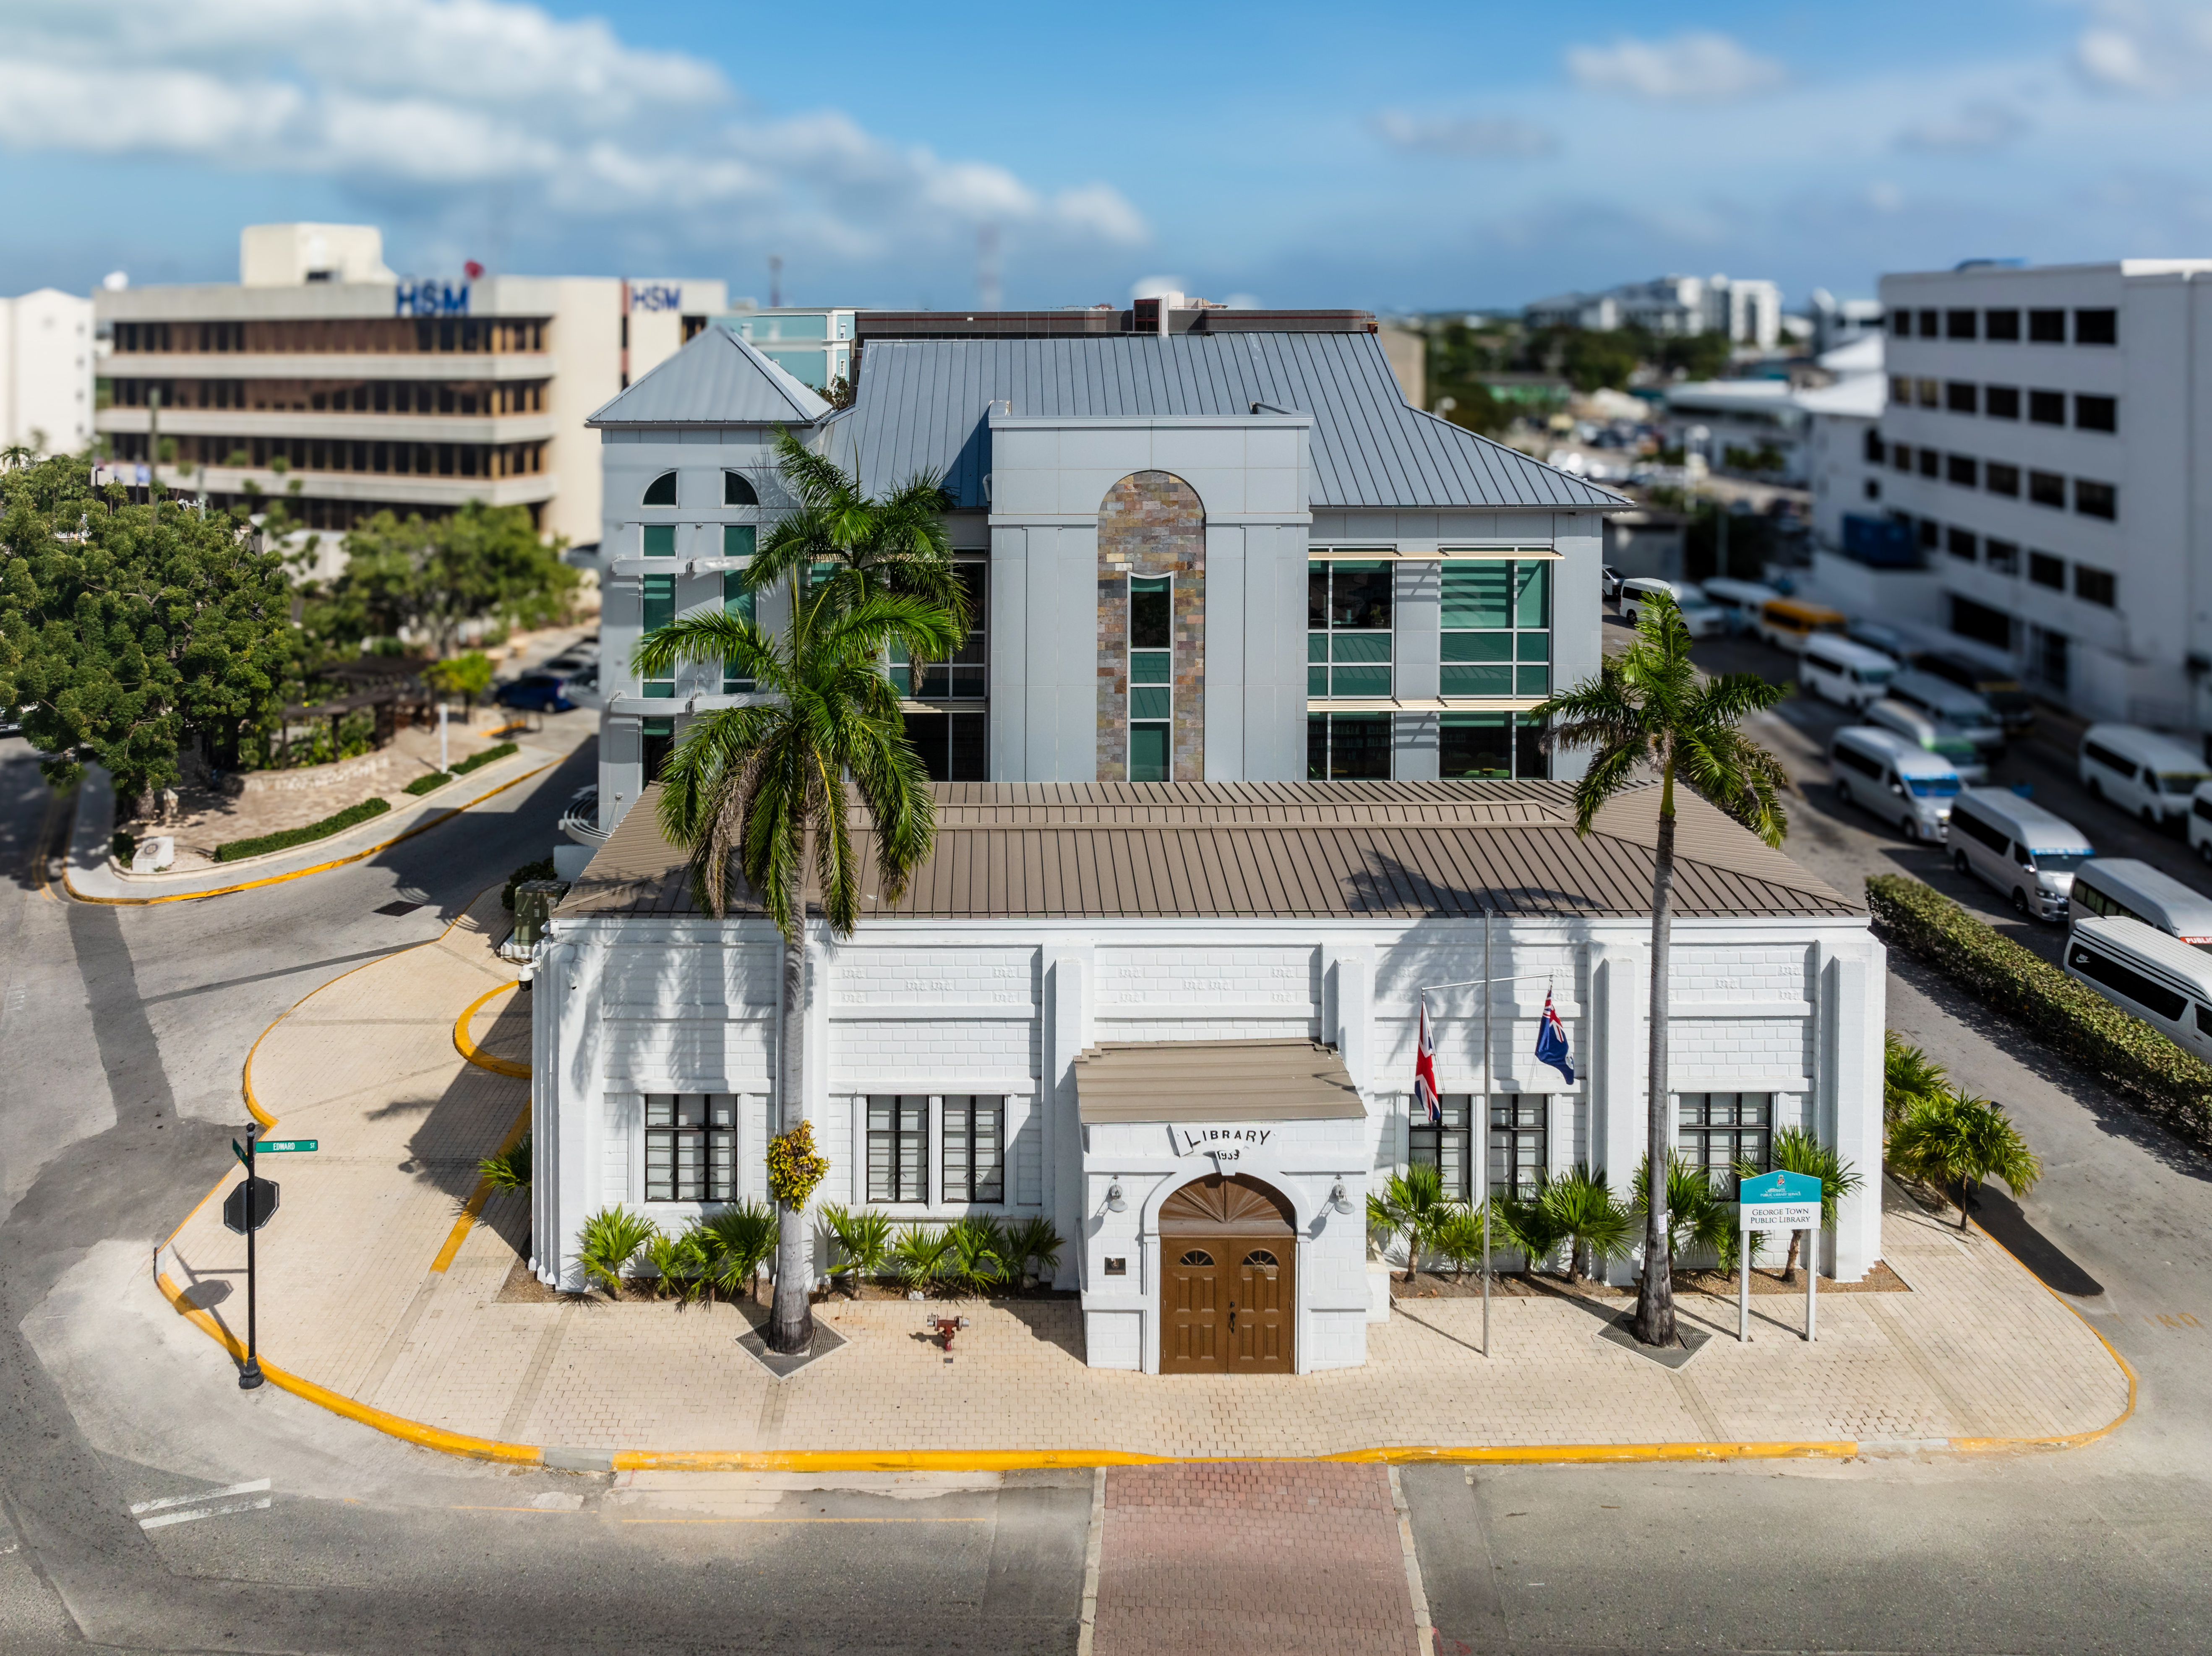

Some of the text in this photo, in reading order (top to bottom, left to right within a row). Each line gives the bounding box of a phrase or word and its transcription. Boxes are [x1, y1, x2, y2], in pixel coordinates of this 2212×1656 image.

[395, 280, 470, 316] HSM
[631, 285, 681, 312] HSM
[1184, 1130, 1271, 1147] LIBRARY
